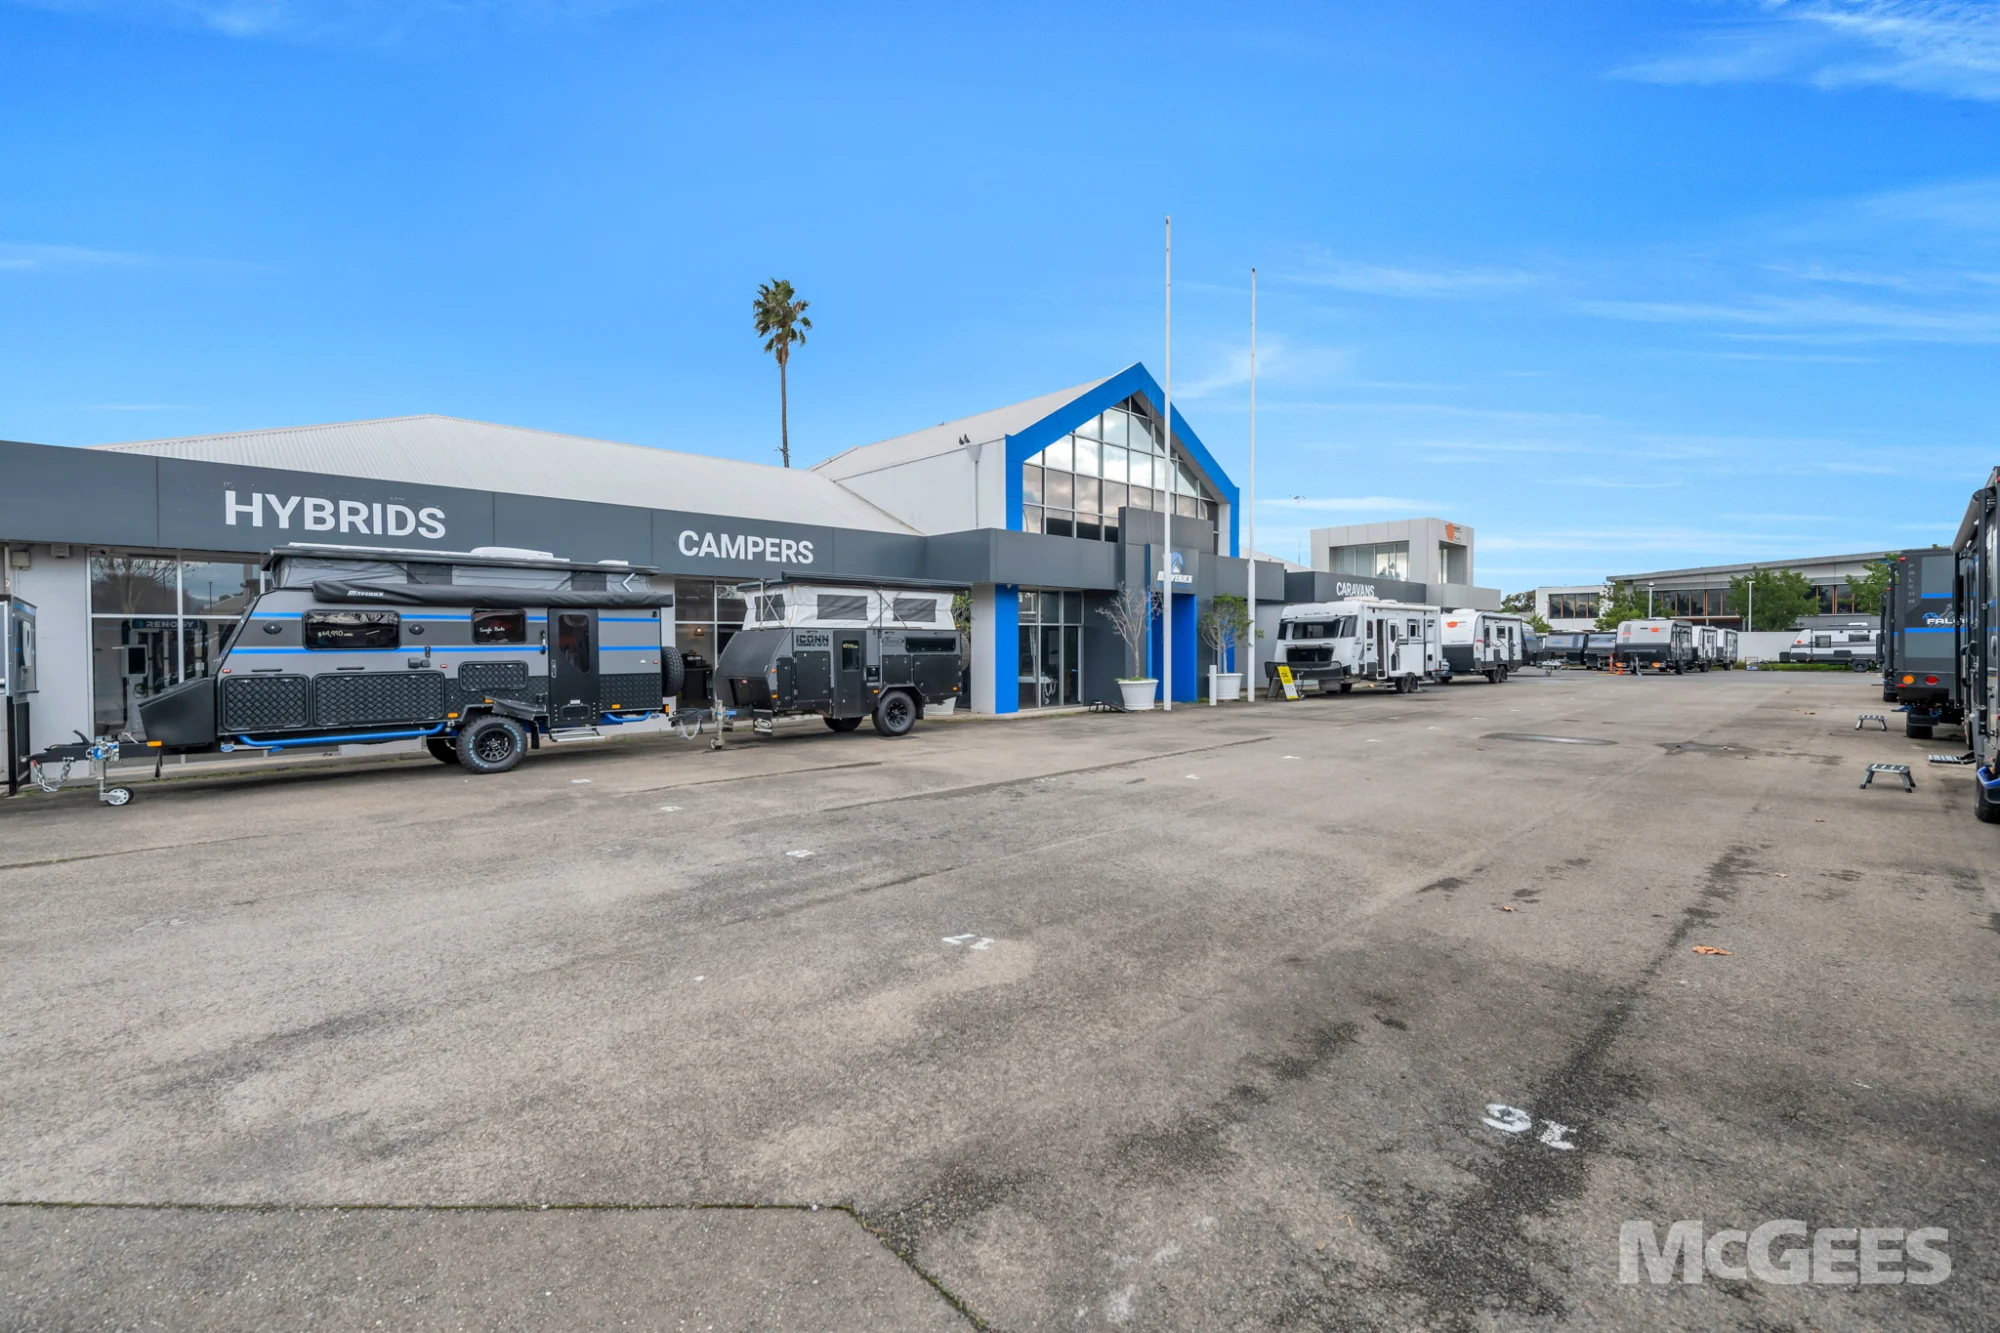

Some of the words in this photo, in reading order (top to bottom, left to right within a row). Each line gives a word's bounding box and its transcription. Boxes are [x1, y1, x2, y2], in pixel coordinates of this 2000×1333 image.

[225, 490, 446, 539] HYBRIDS
[679, 530, 814, 564] CAMPERS
[1157, 570, 1193, 583] MVERICK
[1336, 581, 1375, 597] CARAVANS
